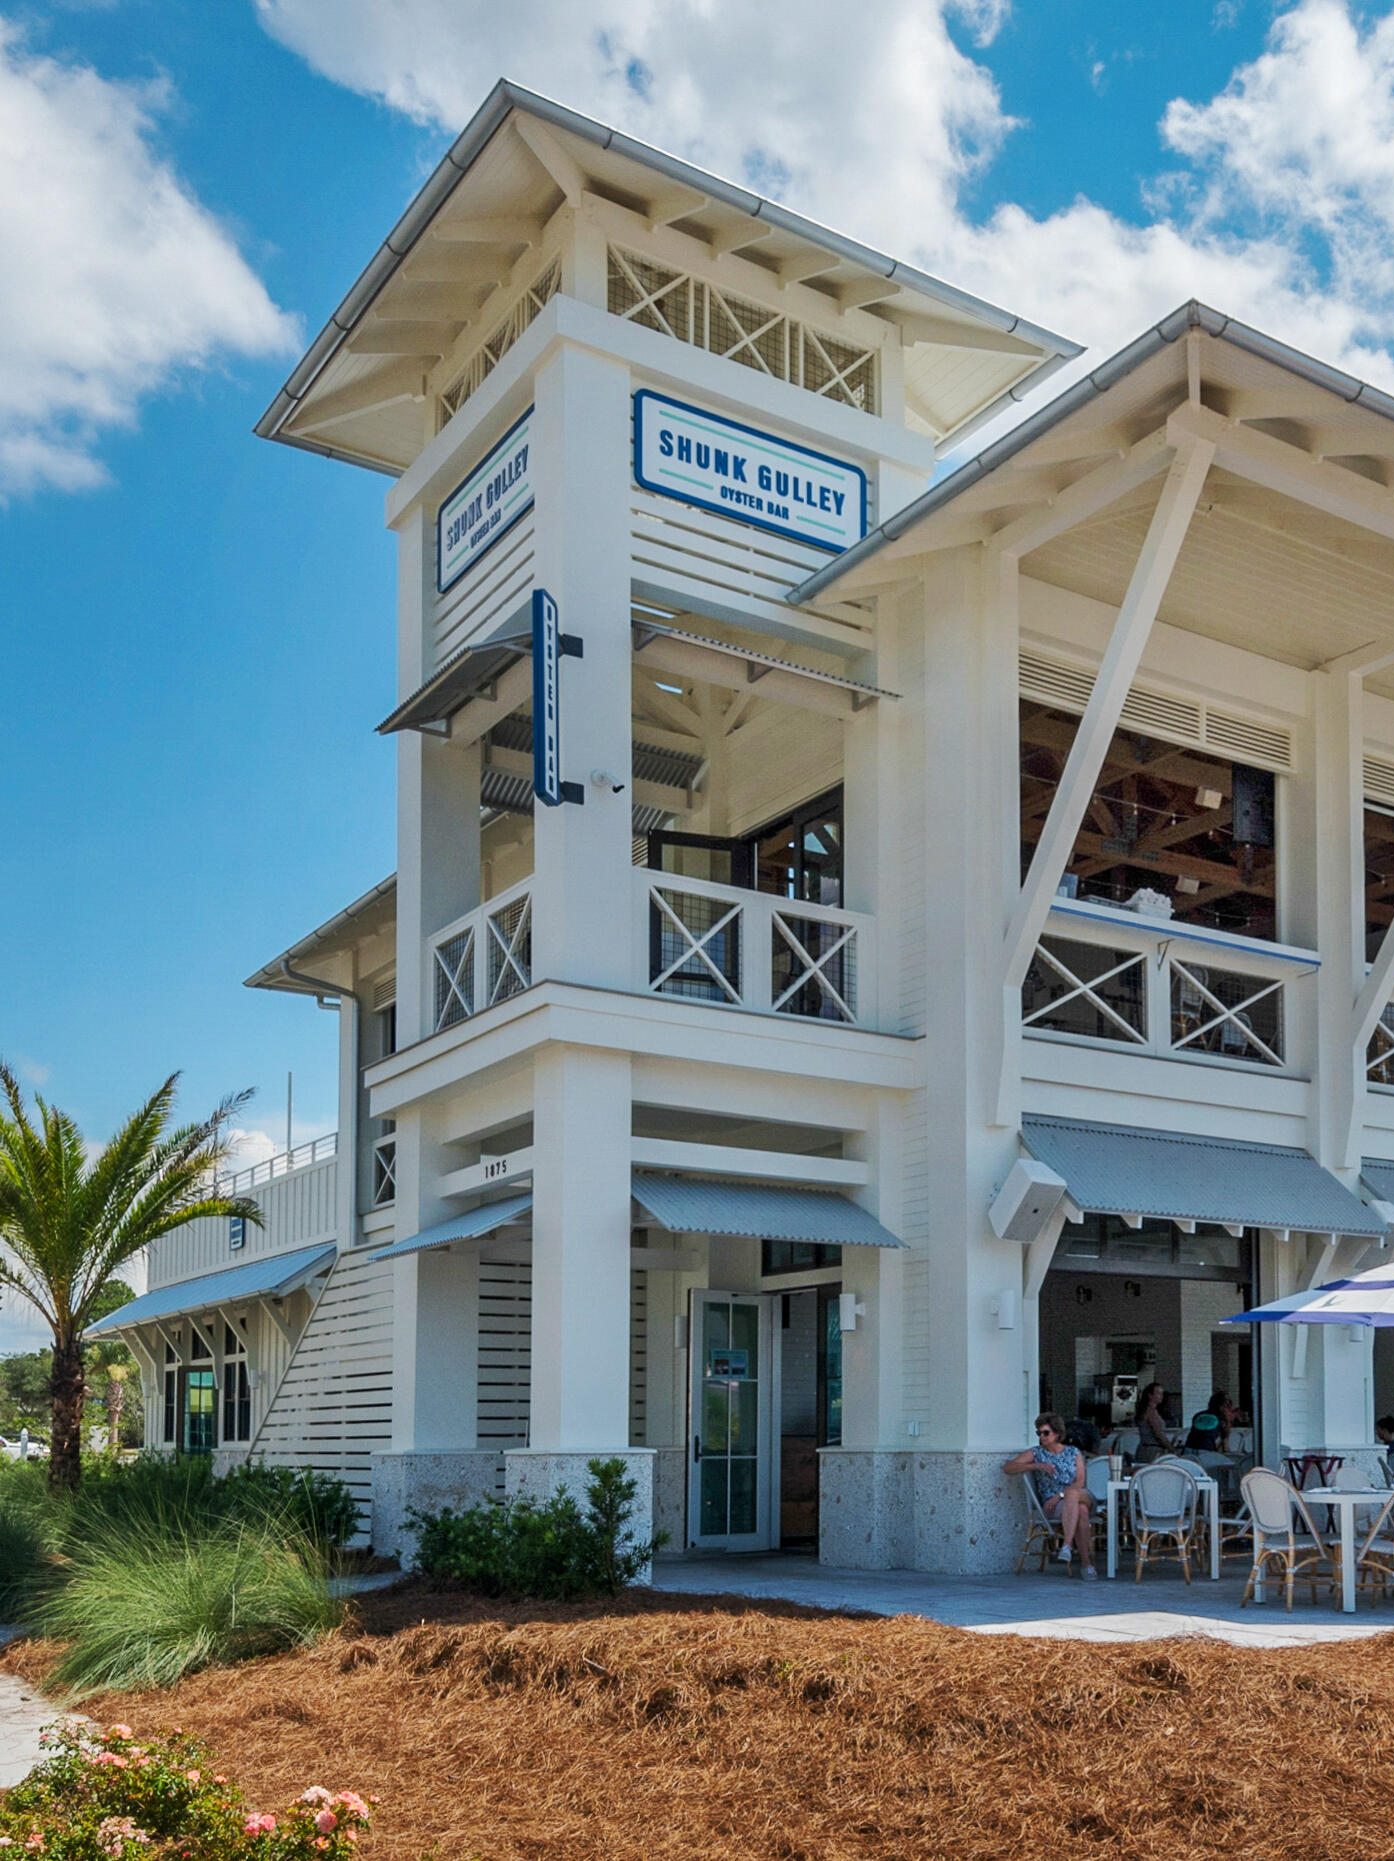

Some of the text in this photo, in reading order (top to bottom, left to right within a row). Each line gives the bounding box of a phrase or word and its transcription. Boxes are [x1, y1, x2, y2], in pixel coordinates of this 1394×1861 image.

[447, 443, 529, 552] SHUNK GULLEY
[659, 429, 845, 516] SHUNK GULLEY
[720, 485, 789, 520] OYSTER BAR
[485, 1160, 507, 1179] 1875
